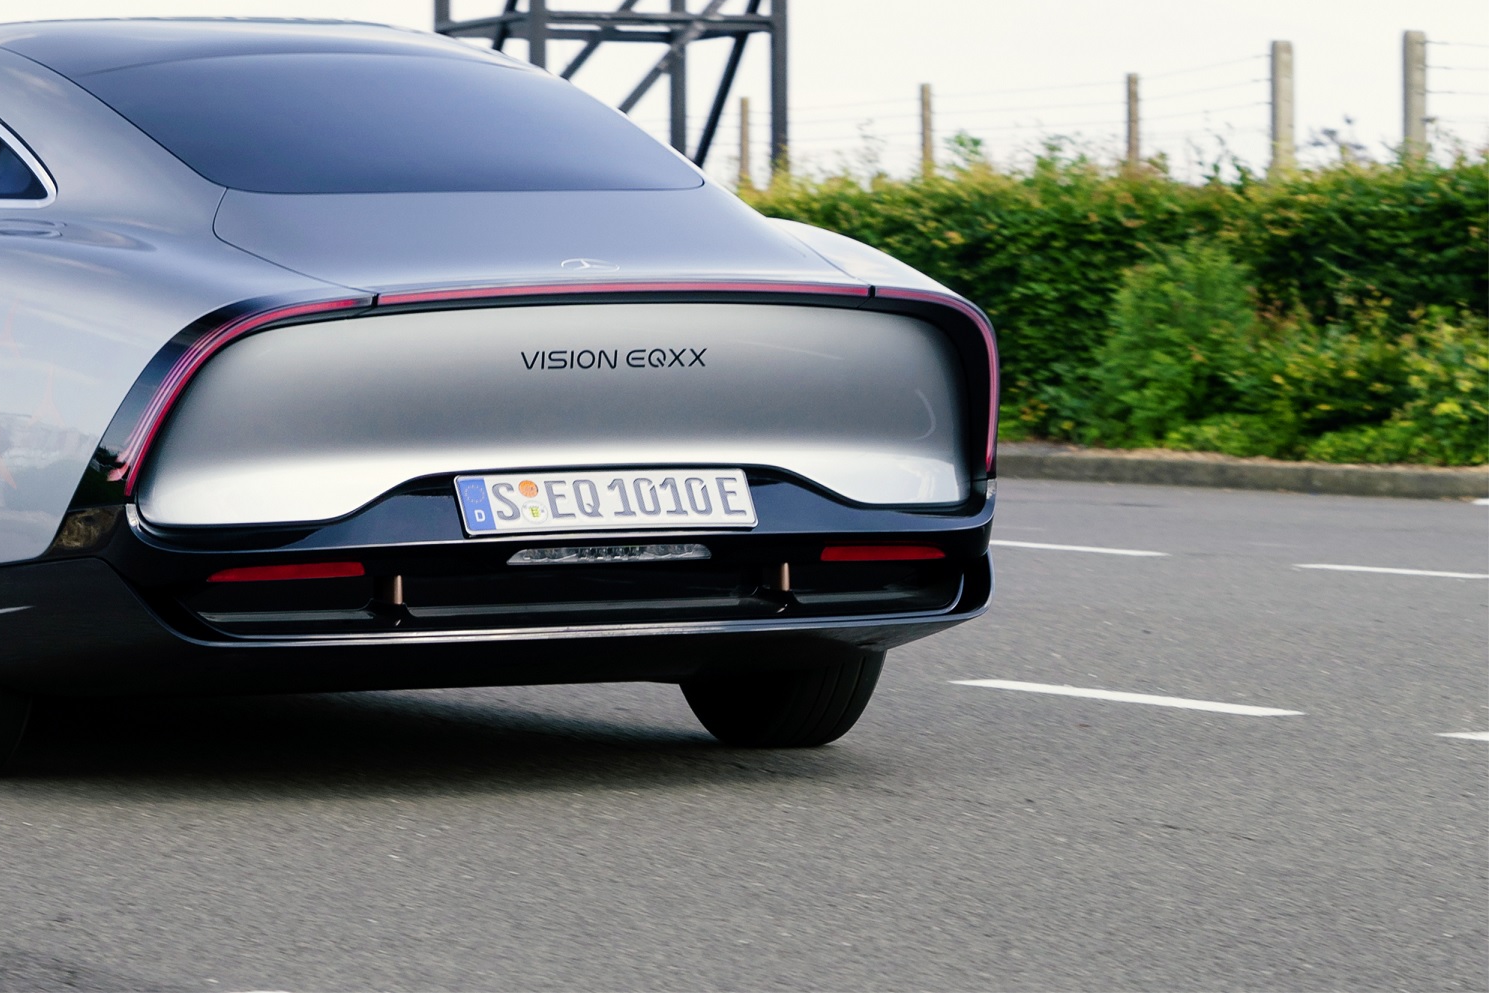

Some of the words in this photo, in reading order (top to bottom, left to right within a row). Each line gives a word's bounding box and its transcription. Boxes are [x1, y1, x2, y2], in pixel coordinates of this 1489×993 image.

[520, 349, 618, 370] VISION
[625, 348, 708, 369] EQXX
[474, 509, 486, 523] D
